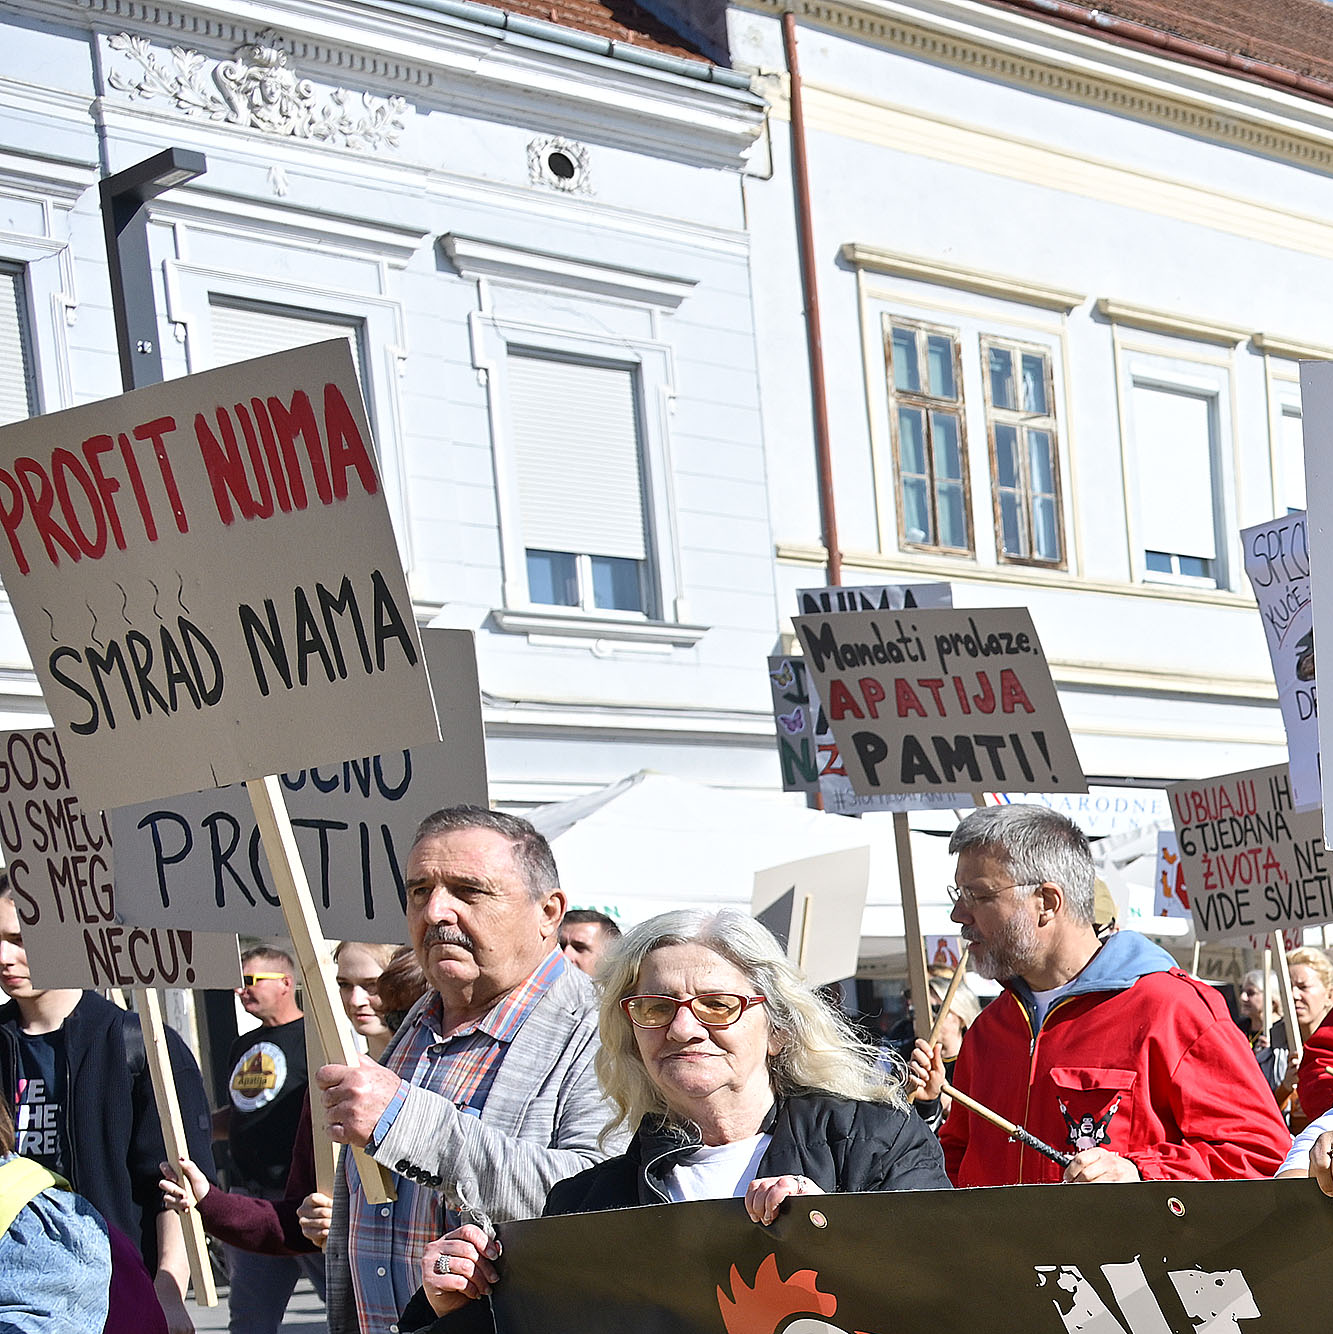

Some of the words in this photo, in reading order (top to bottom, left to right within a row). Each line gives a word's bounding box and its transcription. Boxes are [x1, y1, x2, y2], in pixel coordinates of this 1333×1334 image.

[0, 414, 190, 576] PROFIT
[48, 608, 225, 737] SMRAD
[238, 568, 419, 698] NAMA
[801, 618, 927, 673] Mandati
[829, 668, 1036, 721] APATIJA
[851, 731, 1059, 787] PAMTI!
[1174, 779, 1258, 825] UBIJAJU
[1268, 775, 1293, 812] IH
[1179, 827, 1198, 857] 6
[1195, 811, 1293, 854] TJEDANA
[1201, 846, 1289, 891] ŽIVOTA,
[1293, 838, 1327, 878] NE
[9, 858, 41, 926] S
[1195, 888, 1256, 932] VIDE
